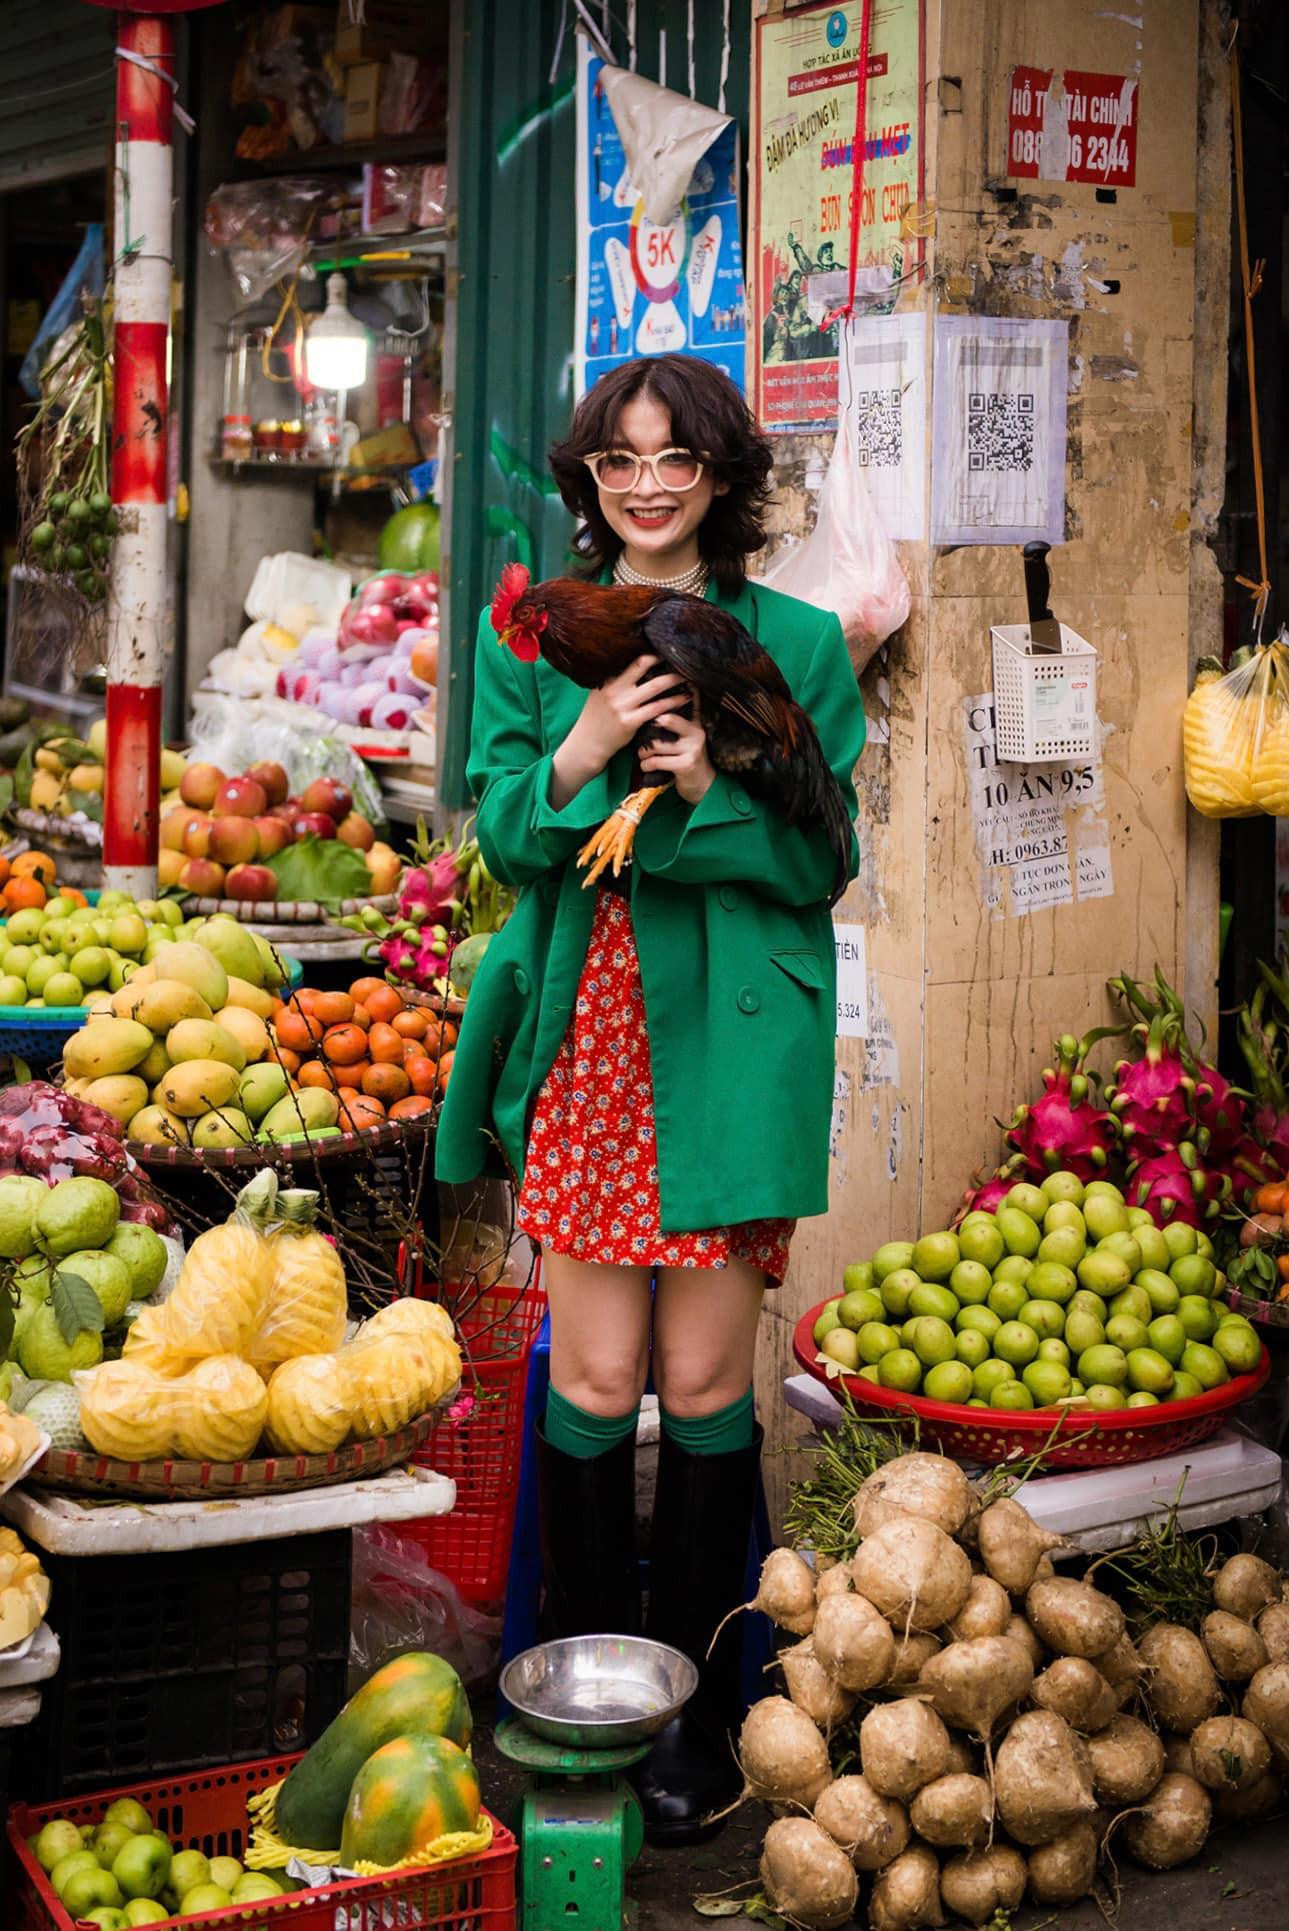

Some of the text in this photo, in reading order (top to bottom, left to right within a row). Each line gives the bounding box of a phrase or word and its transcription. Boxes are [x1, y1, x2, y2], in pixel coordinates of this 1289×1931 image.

[1012, 80, 1032, 117] HỖ
[1065, 89, 1087, 122] TÀI
[766, 98, 840, 174] ĐẬM ĐÀ HƯƠNG VỊ
[1086, 135, 1130, 173] 2344
[820, 183, 841, 233] BÚN
[647, 228, 676, 268] 5K
[985, 782, 1009, 808] 10
[1061, 766, 1094, 796] 9,5
[838, 1002, 861, 1020] 5.324
